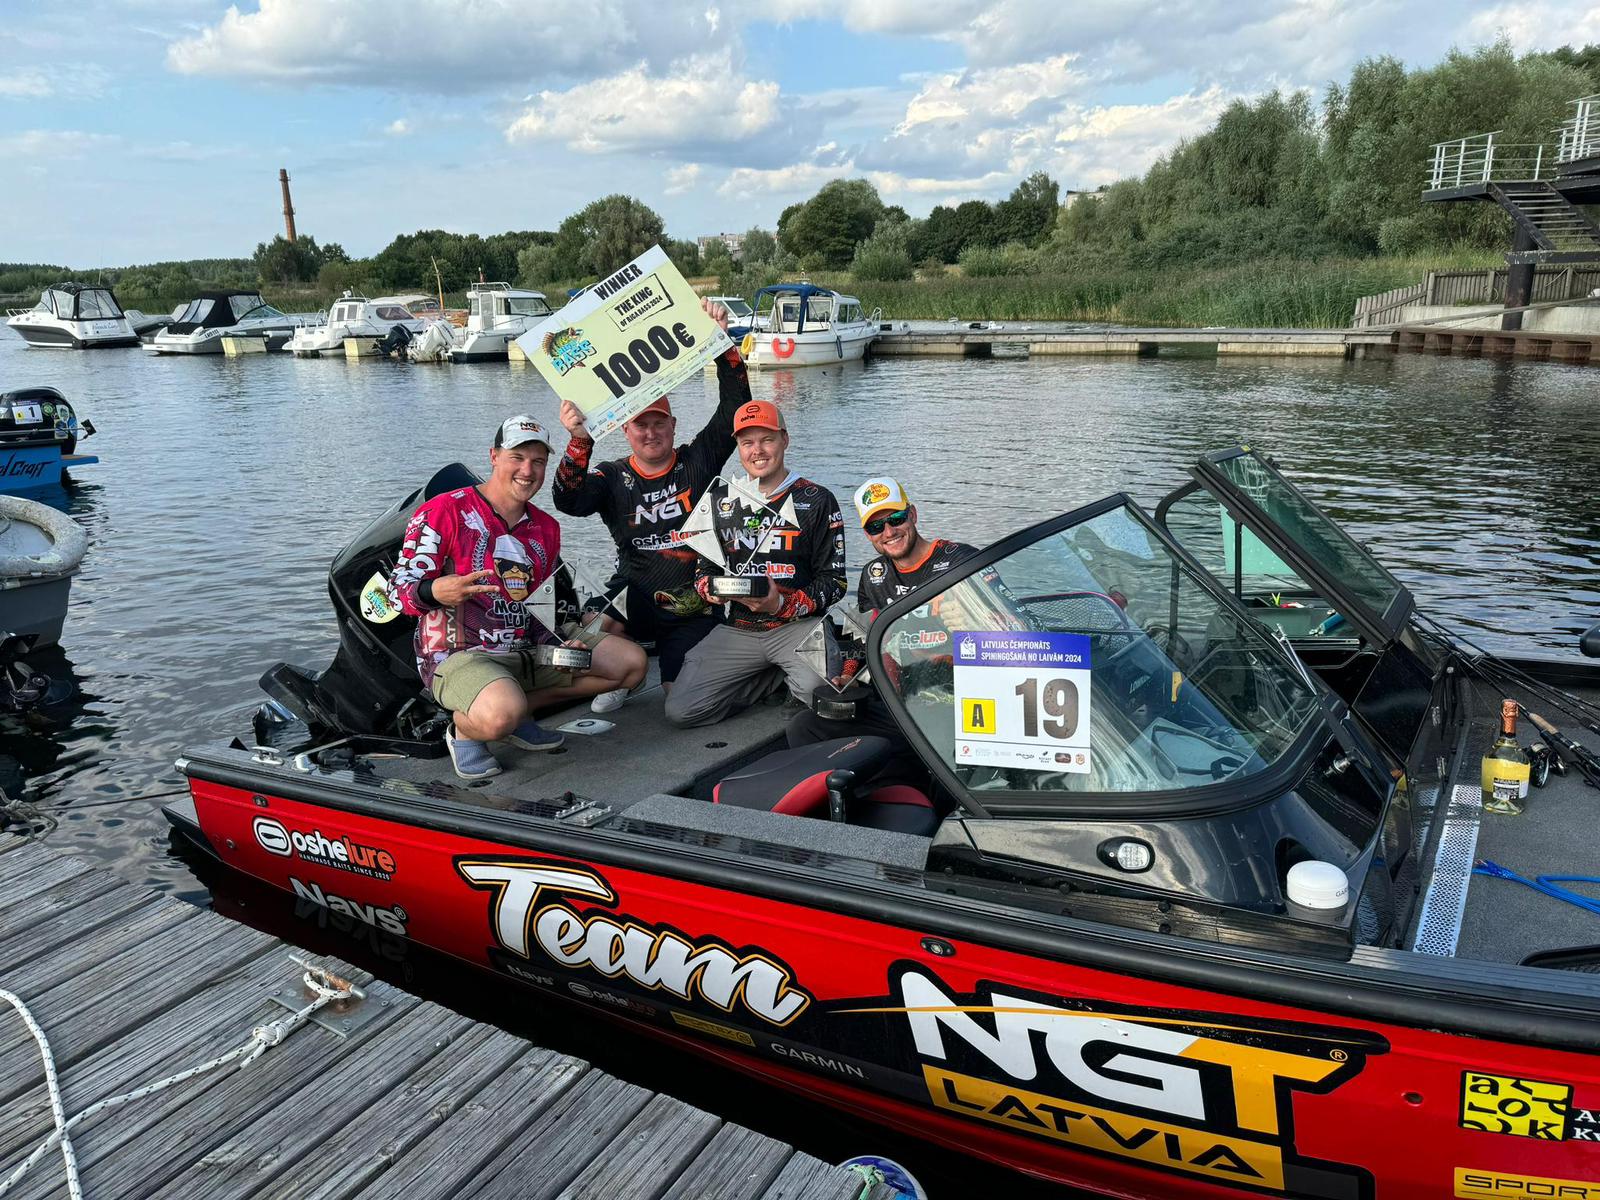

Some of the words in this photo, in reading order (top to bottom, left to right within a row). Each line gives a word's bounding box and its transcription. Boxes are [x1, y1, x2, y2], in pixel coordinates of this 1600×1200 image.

[593, 263, 643, 301] WINNER
[614, 299, 635, 316] THE
[630, 287, 653, 306] KING
[592, 322, 696, 398] 1000€
[635, 488, 693, 525] NGT
[642, 482, 677, 503] TEAM
[743, 516, 786, 527] TAM
[364, 607, 373, 617] 2
[840, 650, 866, 659] PLAC
[981, 640, 1009, 649] LATVIJAS
[1009, 639, 1051, 650] ČEMPIONĀTS
[1027, 653, 1038, 662] NO
[1038, 652, 1064, 662] LAIVĀM
[1064, 654, 1082, 663] 2024
[972, 703, 984, 727] A
[1015, 677, 1079, 740] 19
[291, 830, 395, 872] oshelure
[298, 852, 332, 866] HANDMADE
[333, 861, 352, 871] BAITS
[353, 866, 372, 876] SINCE
[374, 871, 390, 880] 2020
[458, 861, 810, 1026] Team
[770, 1042, 865, 1079] GARMIN
[940, 1077, 1266, 1179] LATVIA
